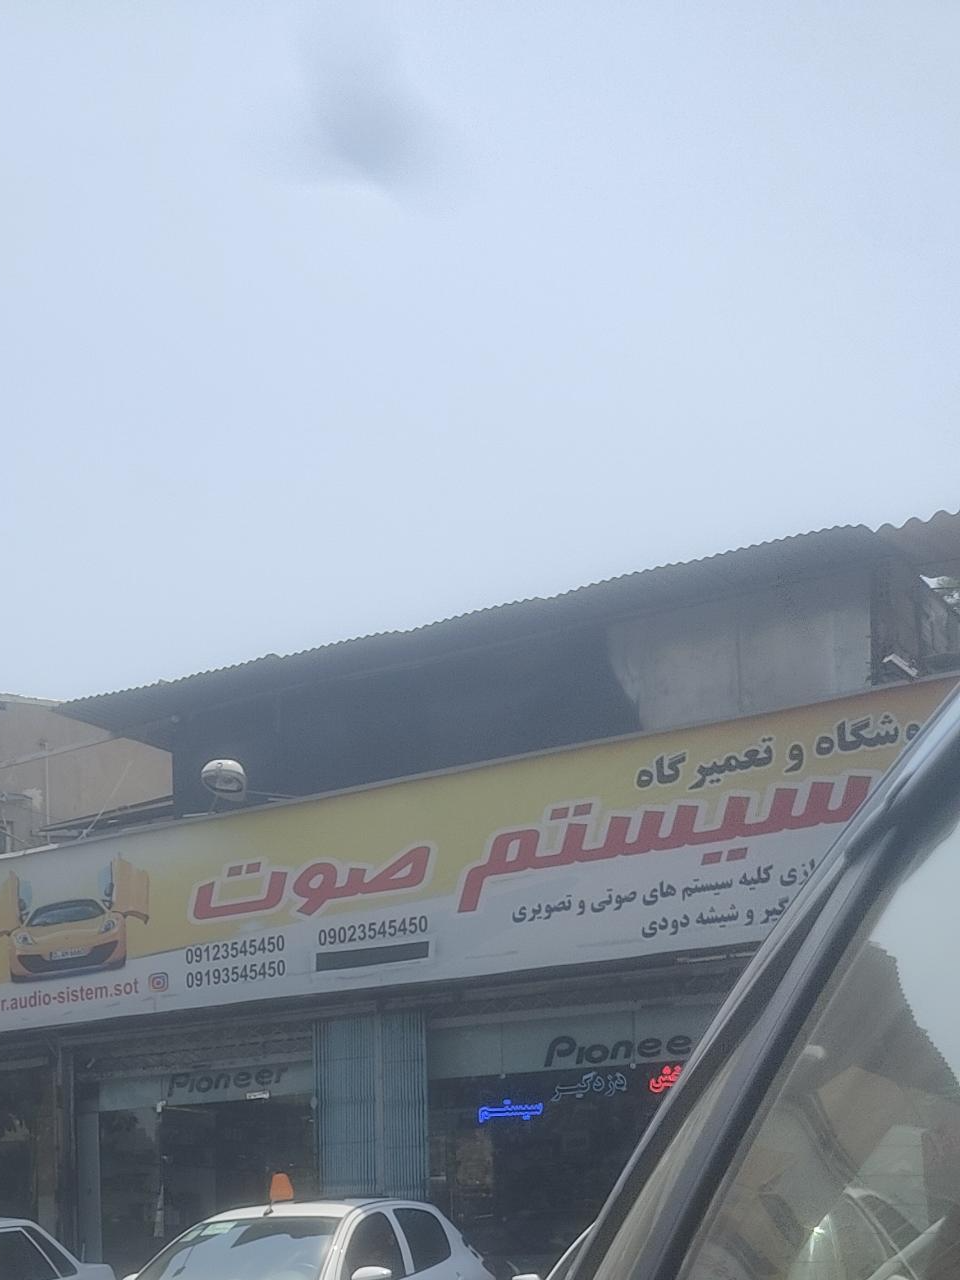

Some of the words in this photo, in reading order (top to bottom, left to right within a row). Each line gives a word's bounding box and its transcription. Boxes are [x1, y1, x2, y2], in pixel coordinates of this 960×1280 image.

[816, 714, 921, 756] شگاه
[785, 743, 805, 772] و
[457, 776, 873, 913] سیستم
[193, 845, 431, 917] صوت
[682, 876, 733, 900] سیستم
[739, 864, 773, 891] کلیه
[576, 899, 586, 915] و
[591, 888, 637, 913] صوتی
[642, 881, 677, 906] های
[512, 894, 572, 923] تصویری
[695, 903, 739, 929] شیشه
[744, 908, 754, 926] و
[318, 915, 428, 946] 09023545450
[641, 913, 690, 938] دودی
[185, 934, 286, 965] 09123545450
[186, 959, 286, 989] 09193545450
[543, 1034, 693, 1068] Pionee
[167, 1065, 289, 1098] Pioneer
[550, 1072, 627, 1102] دزدگیر
[648, 1065, 684, 1093] خش
[477, 1099, 544, 1123] سیستم
